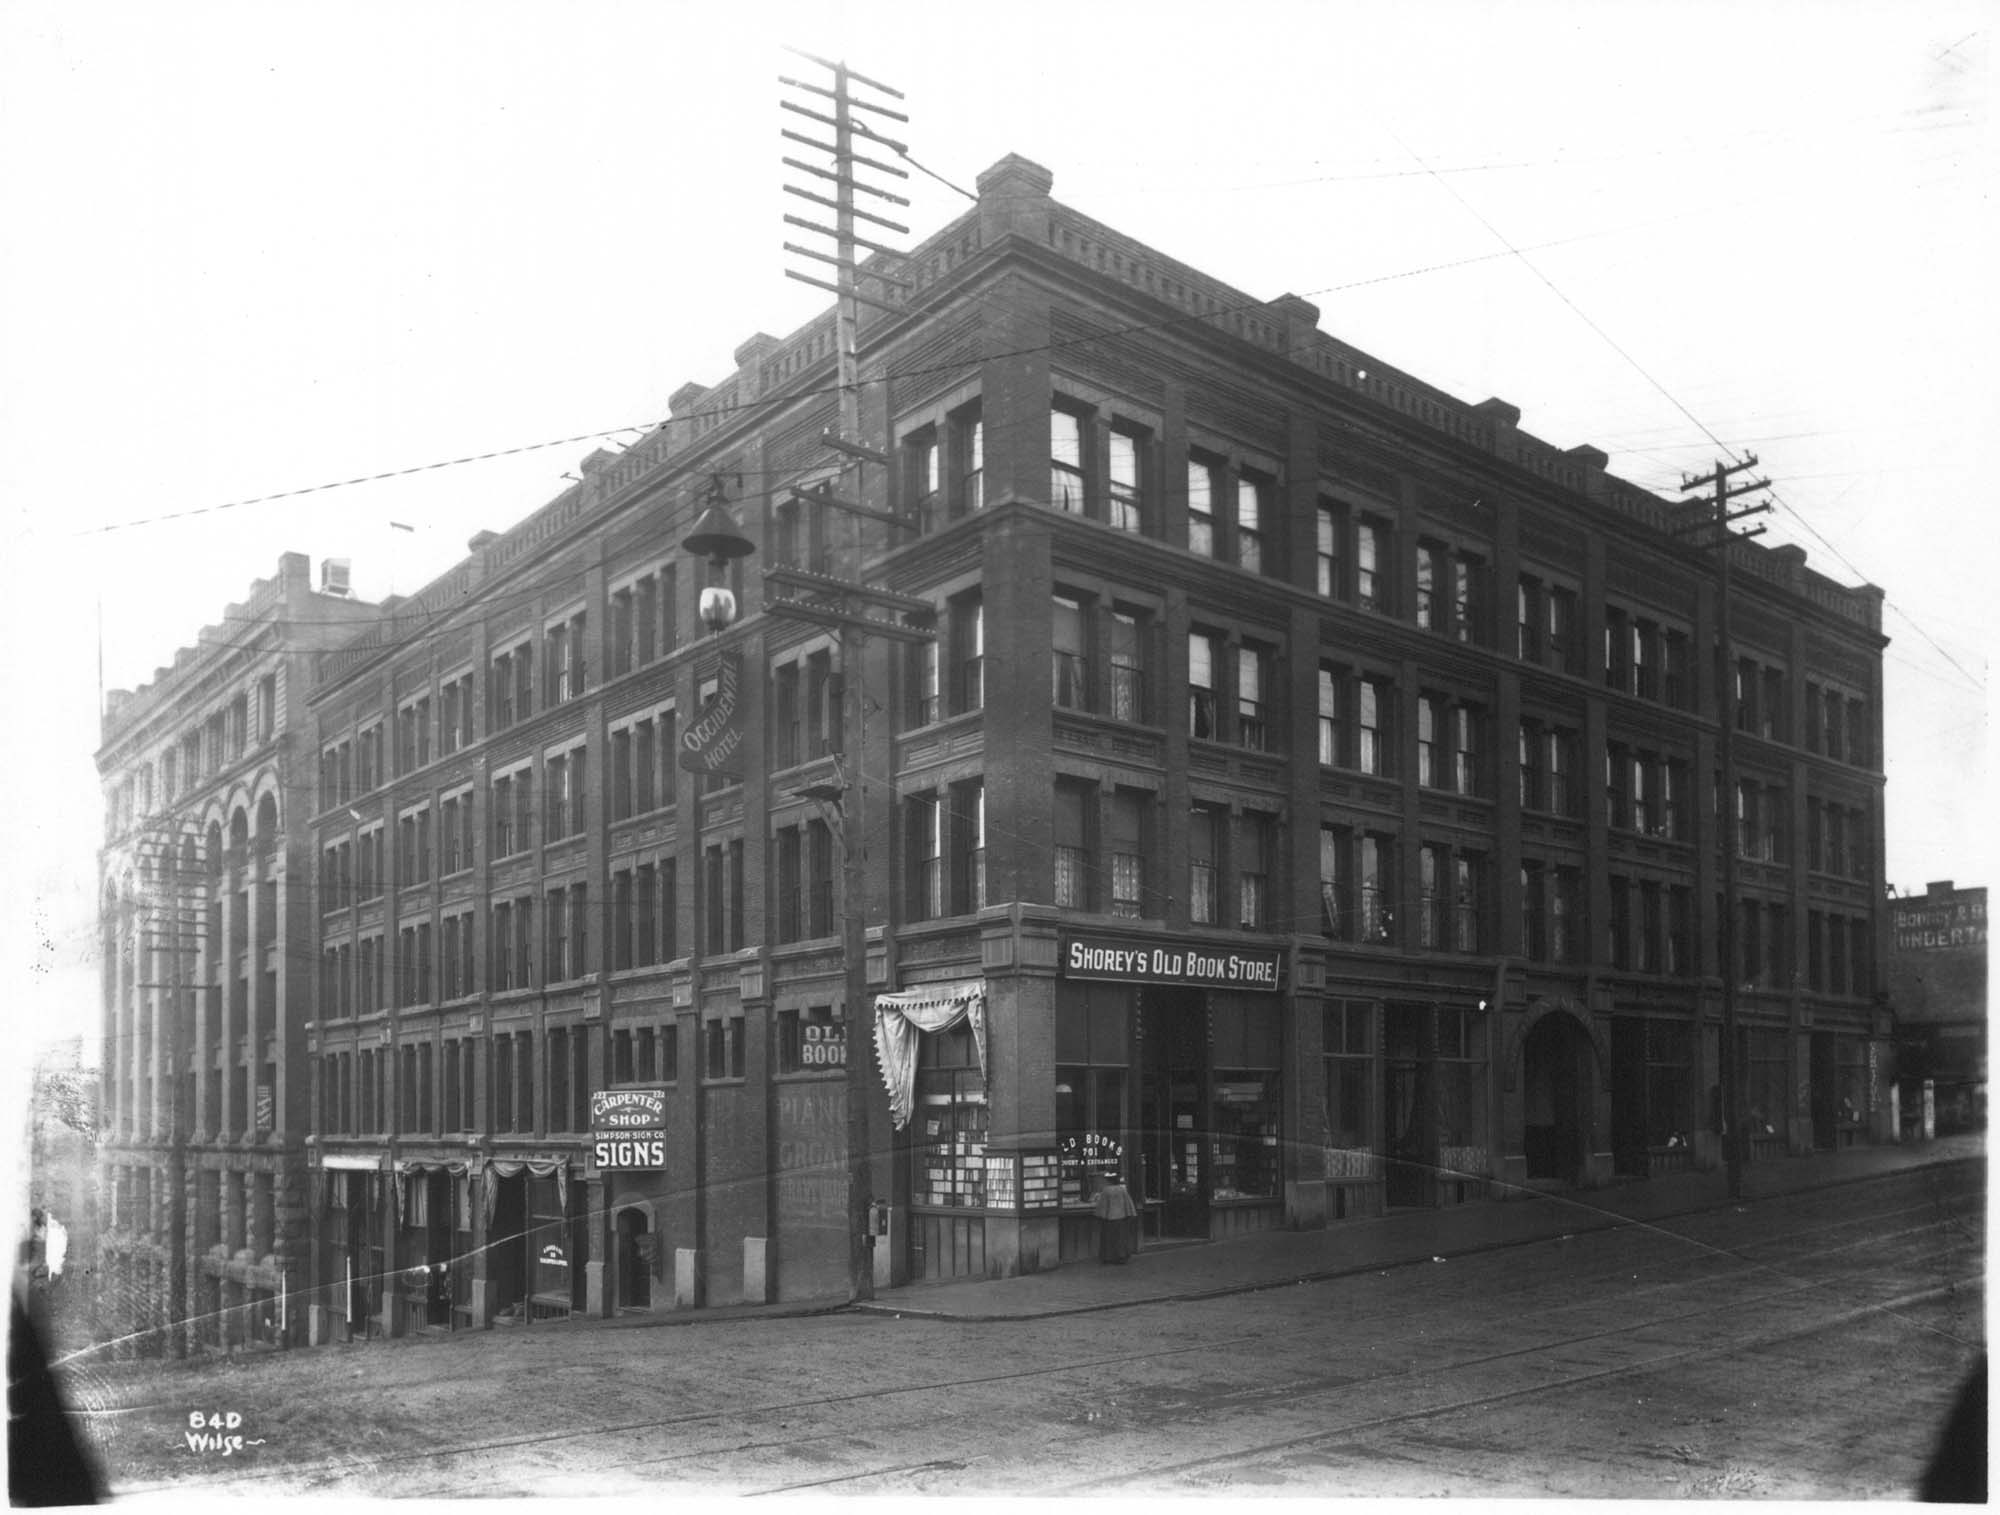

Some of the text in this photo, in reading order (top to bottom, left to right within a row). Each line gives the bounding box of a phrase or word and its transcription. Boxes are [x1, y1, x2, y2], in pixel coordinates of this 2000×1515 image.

[684, 659, 737, 752] OCCIDENTAL
[704, 728, 744, 770] HOTEL
[1070, 942, 1276, 982] SHOREY'S OLD BOOK STORE.
[594, 1093, 662, 1115] CARPENTER
[609, 1114, 650, 1125] SHOP
[632, 1131, 651, 1139] SIGN
[1086, 1134, 1123, 1156] BOOKS
[596, 1141, 664, 1167] SIGNS
[1083, 1147, 1098, 1157] 701
